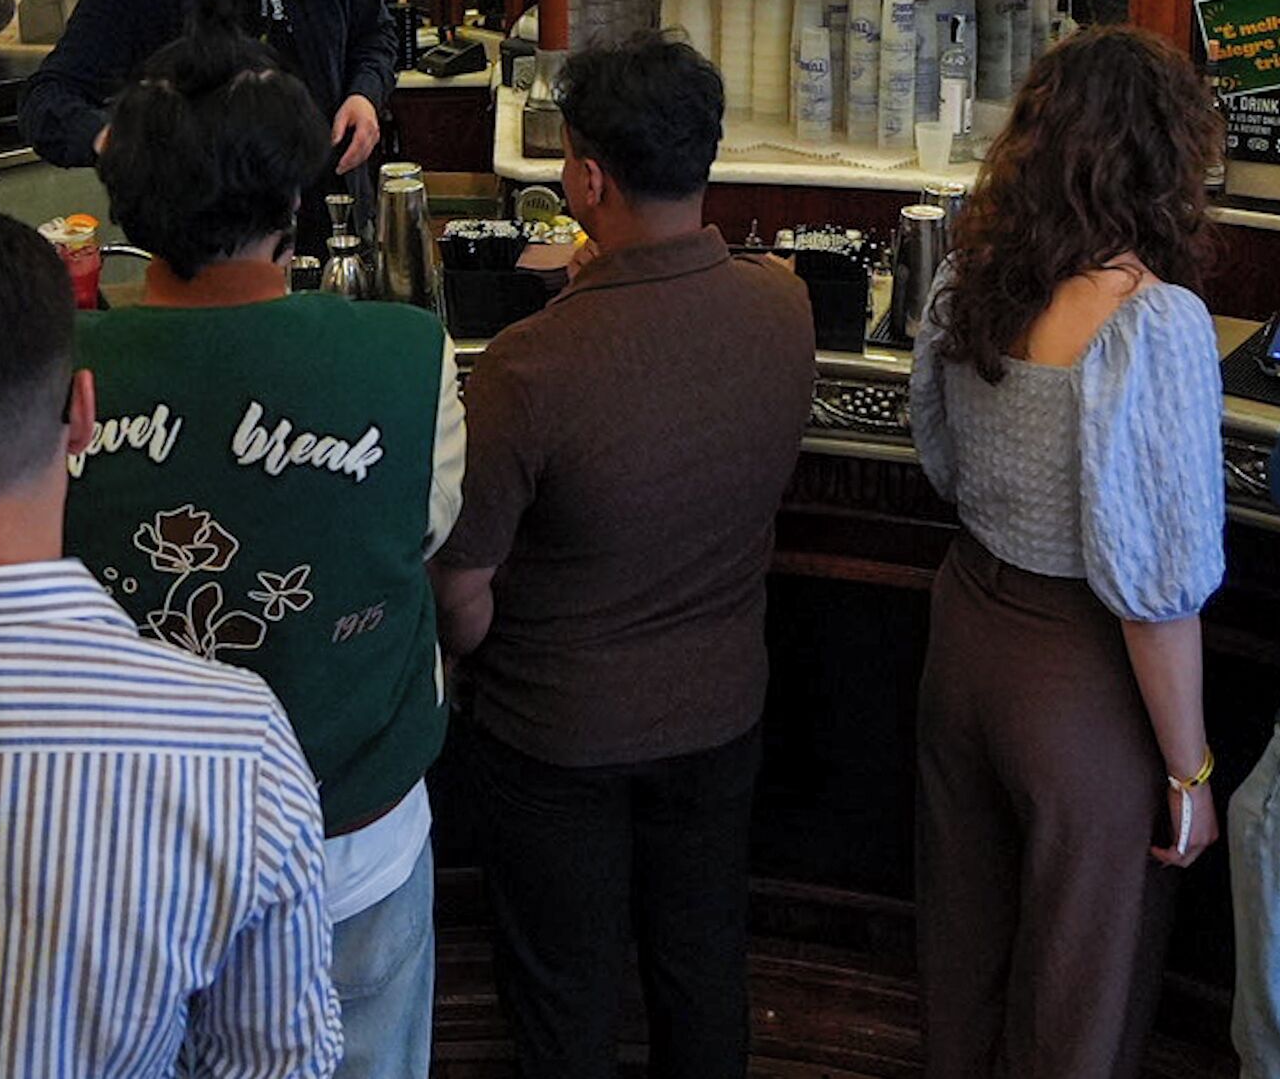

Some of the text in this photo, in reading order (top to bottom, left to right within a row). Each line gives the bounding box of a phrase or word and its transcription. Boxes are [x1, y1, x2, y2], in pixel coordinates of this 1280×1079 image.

[1239, 96, 1280, 114] DRINK
[232, 401, 384, 483] break
[331, 602, 388, 643] 1975
